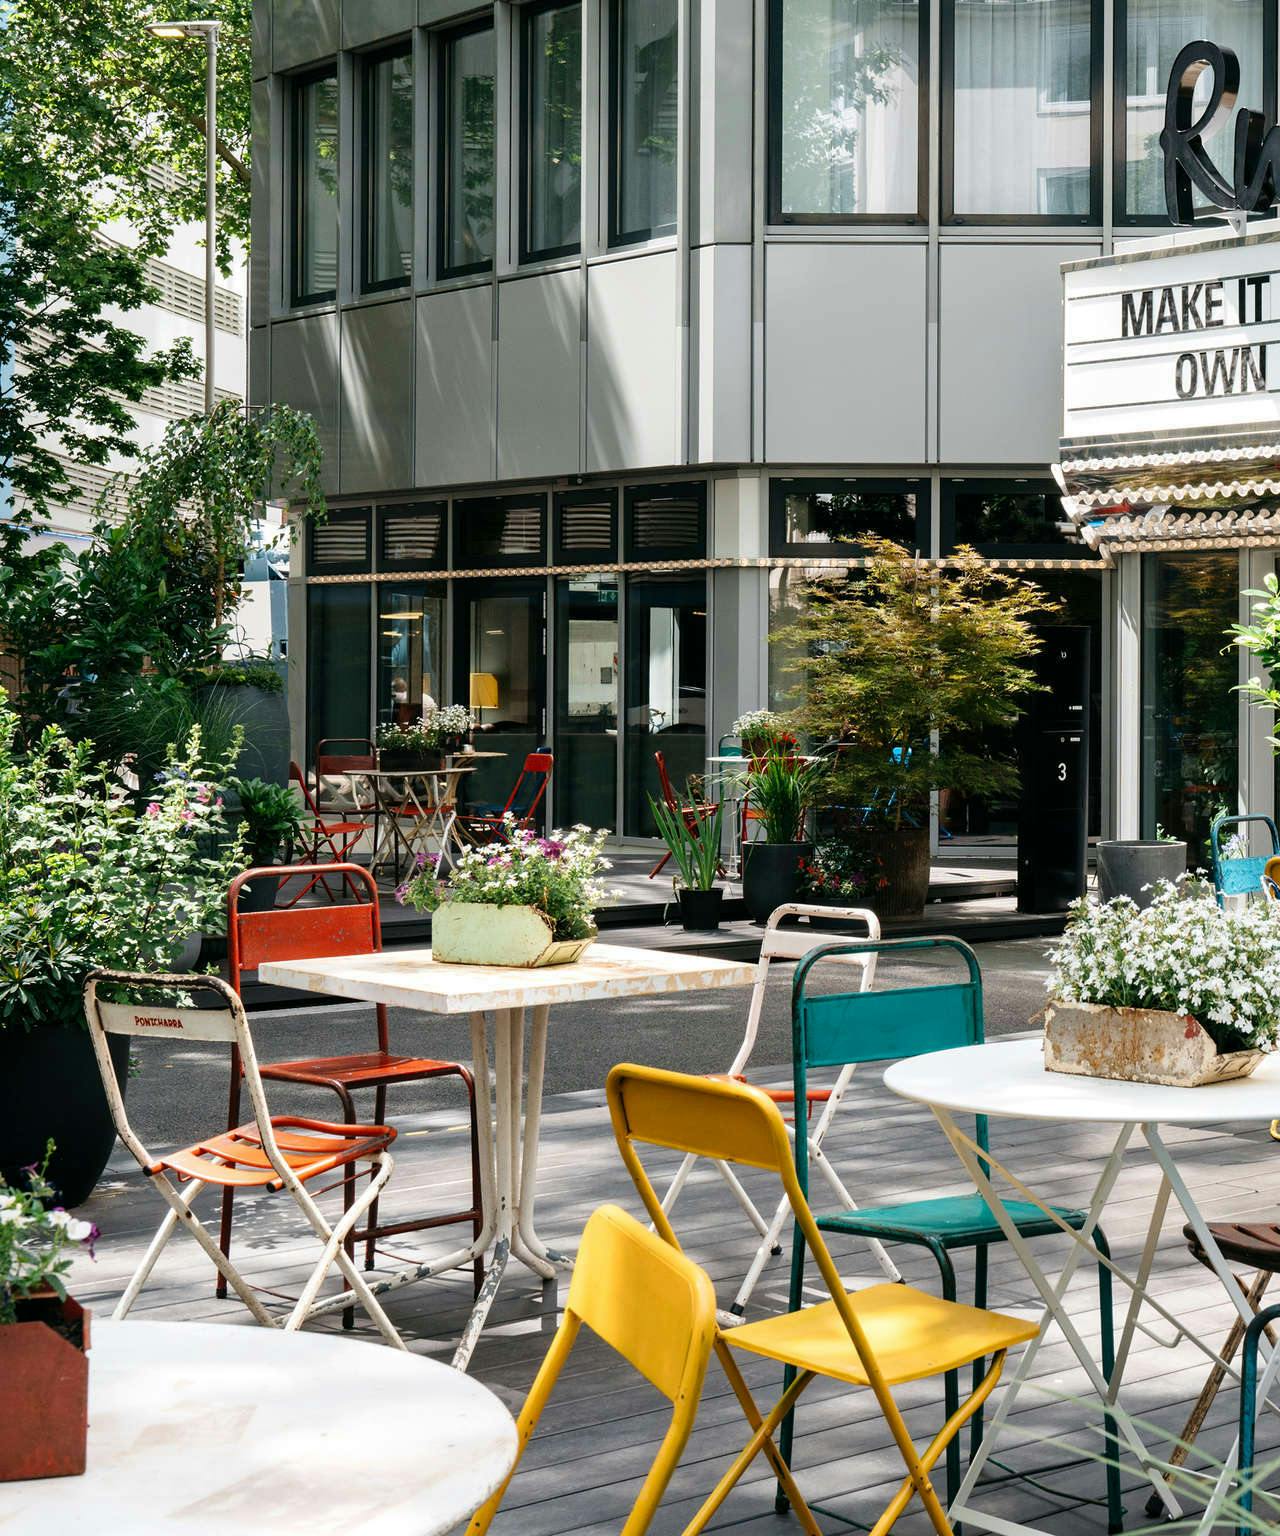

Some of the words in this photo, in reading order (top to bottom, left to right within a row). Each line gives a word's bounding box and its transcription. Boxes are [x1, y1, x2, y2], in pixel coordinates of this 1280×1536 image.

[1122, 282, 1224, 337] MAKE
[1239, 276, 1270, 324] IT
[1175, 345, 1266, 399] OWN
[1058, 762, 1067, 781] 3
